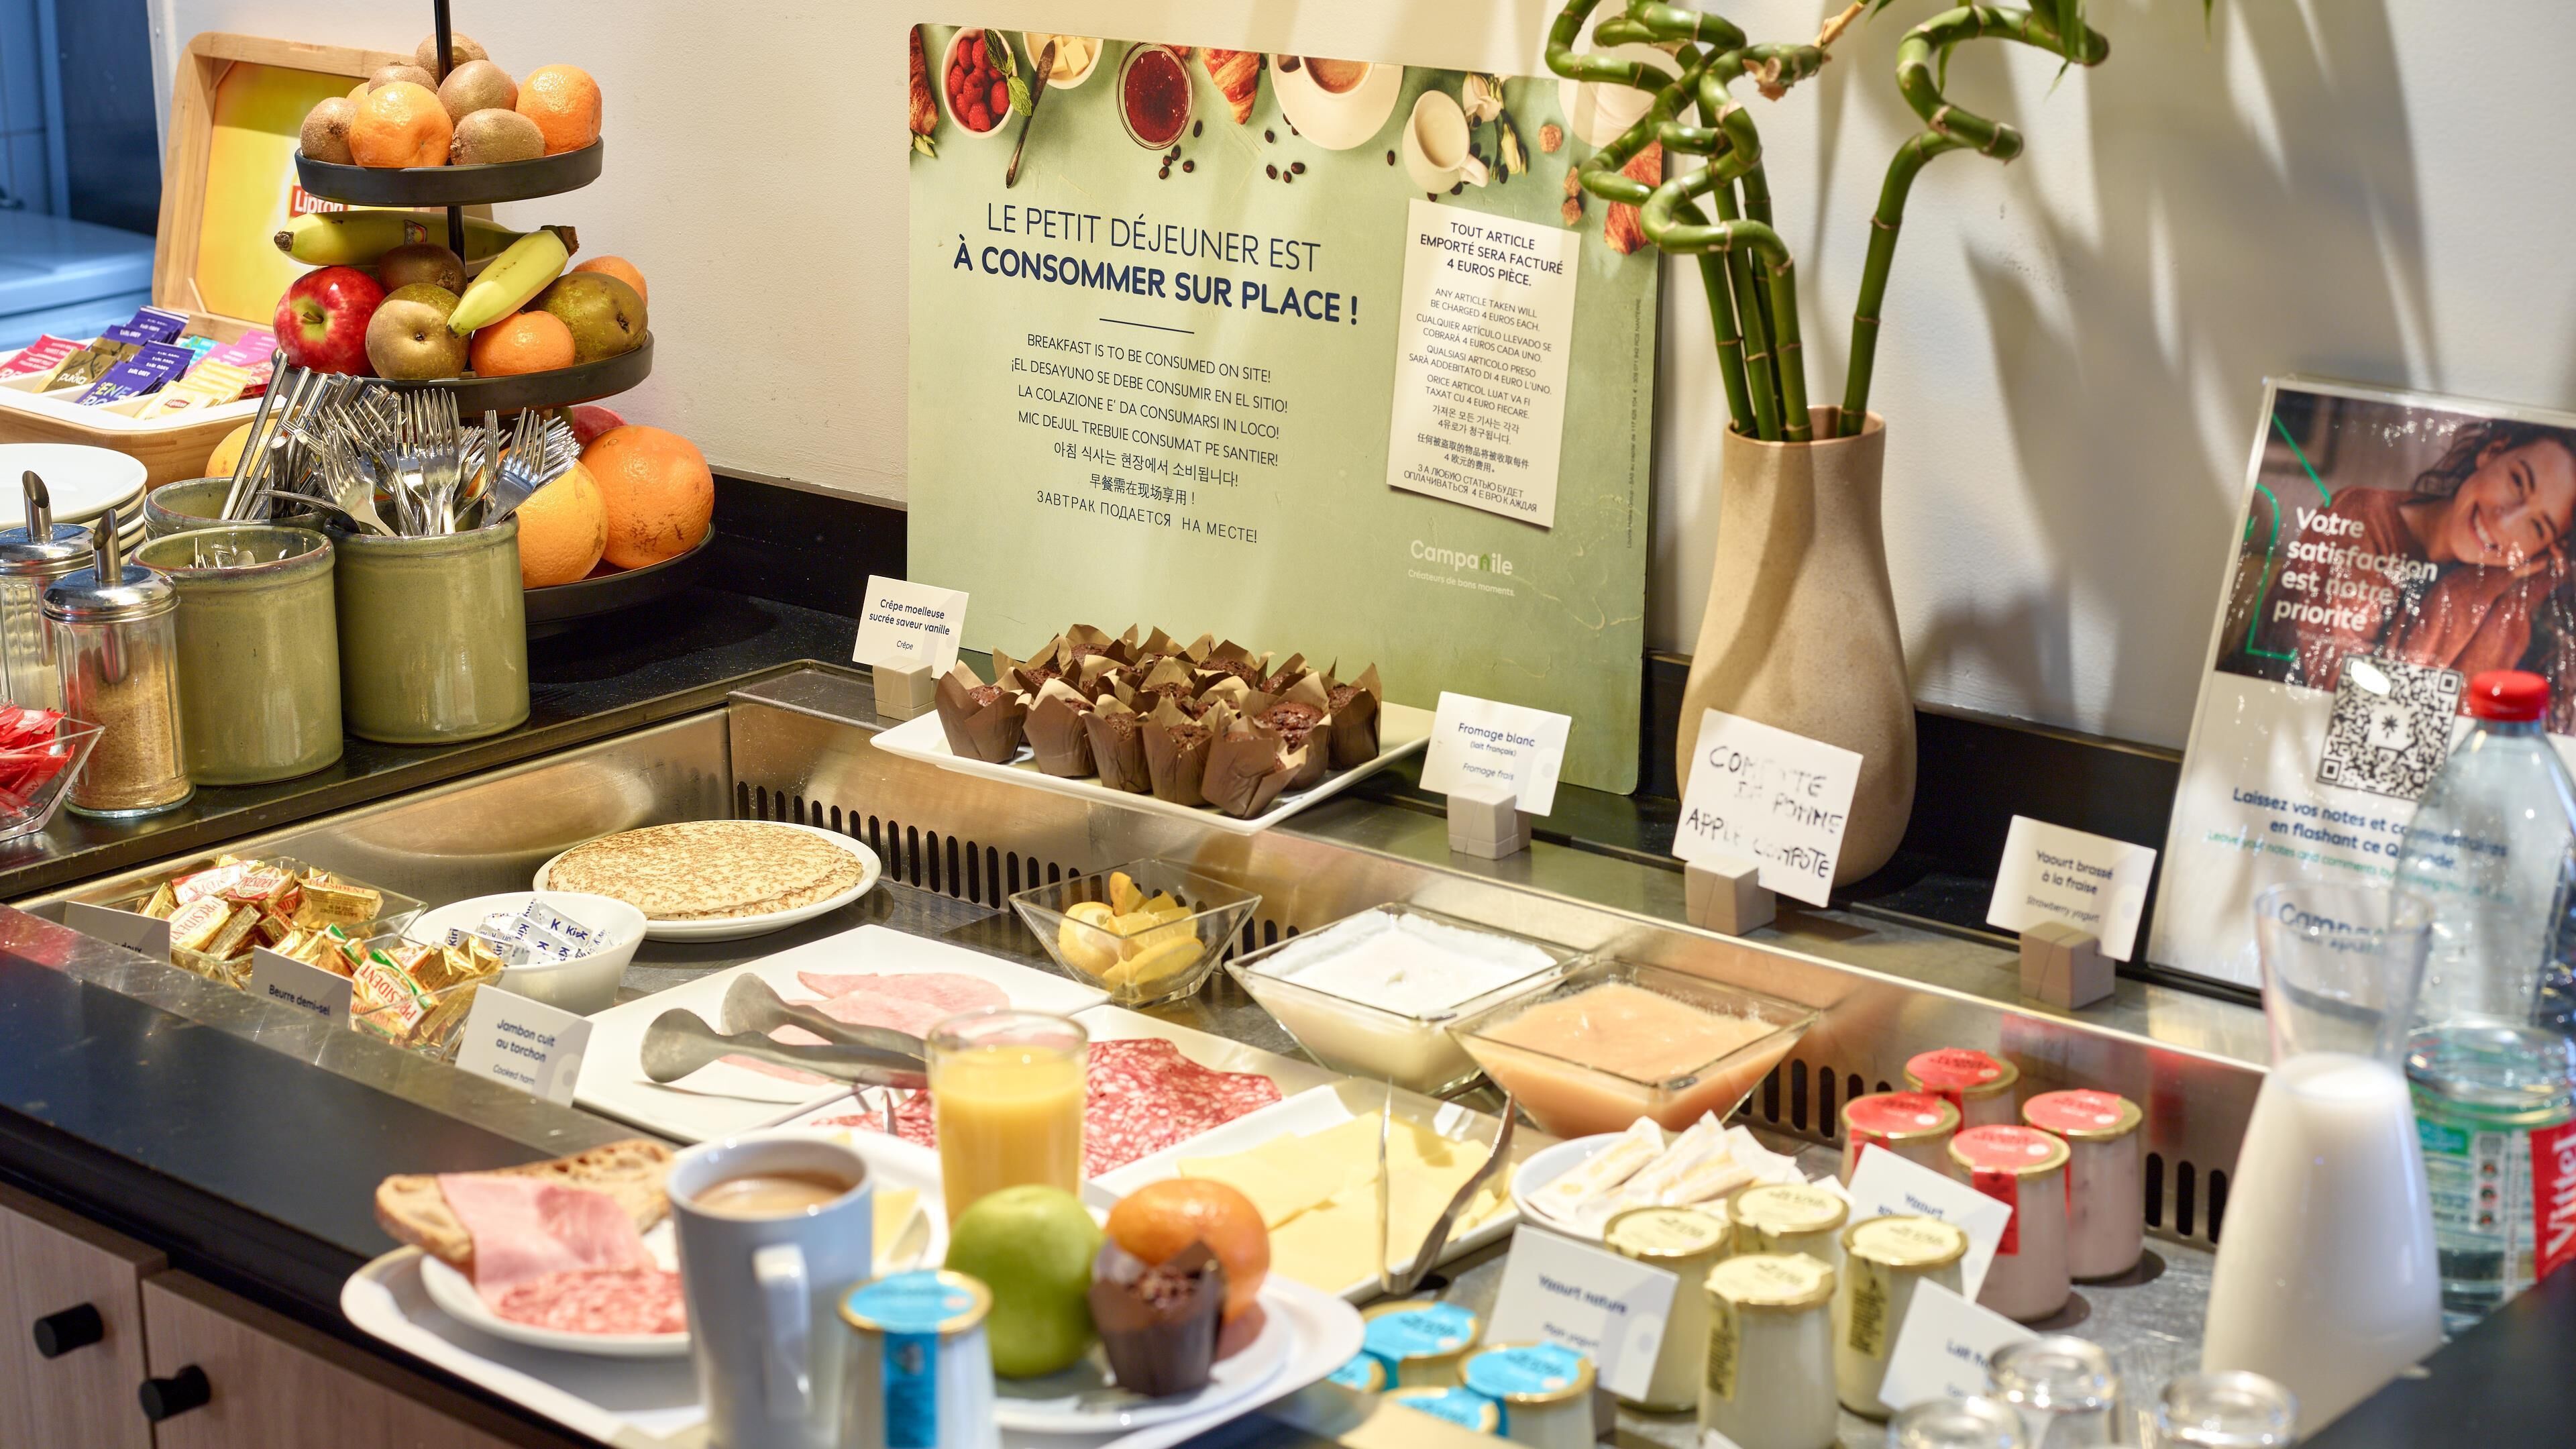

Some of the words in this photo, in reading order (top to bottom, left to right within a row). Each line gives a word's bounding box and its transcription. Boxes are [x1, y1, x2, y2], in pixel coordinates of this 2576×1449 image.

[988, 203, 1016, 233] LE
[1026, 209, 1101, 243] PETIT
[1112, 213, 1258, 265] DÉJEUNER
[1271, 238, 1321, 272] EST
[1451, 222, 1483, 238] TOUT
[1487, 231, 1535, 250] ARTICLE
[1421, 234, 1474, 255] EMPORTÉ
[1478, 246, 1506, 262] SERA
[1510, 254, 1563, 274] FACTURÉ
[954, 234, 973, 270] À
[981, 247, 1165, 298] CONSOMMER
[1175, 272, 1231, 307] SUR
[1242, 282, 1340, 322] PLACE
[1448, 258, 1454, 268] 4
[1458, 260, 1495, 277] EUROS
[1499, 268, 1532, 286] PIÈCE.
[1431, 300, 1440, 309] BE
[1442, 302, 1479, 317] CHARGED
[1489, 313, 1514, 325] EUROS
[1517, 319, 1540, 331] EACH.
[1436, 288, 1452, 298] ANY
[1454, 292, 1487, 307] ARTICLE
[1489, 300, 1515, 313] TAKEN
[1518, 306, 1537, 317] WILL
[1417, 313, 1460, 330] CUALQUIER
[1462, 324, 1501, 339] ARTÍCULO
[1503, 333, 1541, 349] LLEVADO
[1543, 343, 1552, 352] SE
[1424, 328, 1460, 343] COBRARÁ
[1470, 339, 1495, 352] EUROS
[1497, 345, 1519, 356] CADA
[1522, 350, 1542, 362] UNO.
[1028, 334, 1091, 354] BREAKFAST
[1095, 344, 1104, 357] IS
[1108, 346, 1124, 360] TO
[1128, 350, 1142, 362] BE
[1146, 352, 1215, 373] CONSUMED
[1220, 364, 1238, 378] ON
[1242, 367, 1271, 382] SITE!
[1409, 354, 1428, 364] SARÀ
[1431, 360, 1481, 377] ADDEBITATO
[1484, 371, 1491, 380] DI
[1501, 376, 1522, 387] EURO
[1427, 345, 1466, 360] QUALSIASI
[1468, 355, 1508, 370] ARTICOLO
[1511, 365, 1536, 378] PRESO
[1012, 358, 1027, 372] ¡EL
[1031, 361, 1093, 381] DESAYUNO
[1097, 372, 1109, 384] SE
[1114, 374, 1142, 389] DEBE
[1147, 380, 1211, 401] CONSUMIR
[1216, 390, 1231, 404] EN
[1236, 393, 1249, 407] EL
[1253, 396, 1287, 413] SITIO!
[1428, 374, 1449, 386] ORICE
[1452, 381, 1485, 395] ARTICOL
[1488, 389, 1508, 400] LUAT
[1019, 384, 1032, 398] LA
[1036, 388, 1103, 409] COLAZIONE
[1108, 399, 1115, 411] E'
[1120, 401, 1136, 415] DA
[1140, 405, 1219, 429] CONSUMARSI
[1224, 419, 1236, 431] IN
[1241, 421, 1279, 439] LOCO!
[1426, 386, 1452, 399] TAXAT
[1454, 394, 1464, 402] CU
[1474, 398, 1495, 410] EURO
[1497, 405, 1529, 419] FIECARE.
[1433, 405, 1456, 418] 가져온
[1459, 411, 1474, 423] 모든
[1477, 416, 1501, 429] 기사는
[1503, 422, 1519, 434] 각각
[1438, 419, 1466, 433] 4유로가
[1470, 426, 1511, 445] 청구됩니다.
[1019, 411, 1039, 425] MIC
[1043, 415, 1079, 432] DEJUL
[1082, 421, 1128, 440] TREBUIE
[1132, 431, 1201, 452] CONSUMAT
[1206, 442, 1220, 456] PE
[1224, 445, 1277, 466] SANTIER!
[1055, 442, 1077, 459] 아침
[1082, 445, 1116, 465] 식사는
[1121, 452, 1168, 475] 현장에서
[1173, 464, 1238, 486] 소비됩니다!
[1404, 470, 1468, 494] ОПЛАЧИВАТЬСЯ
[1432, 468, 1461, 482] ЛЮБУЮ
[1463, 476, 1496, 490] СТАТЬЮ
[1497, 484, 1523, 498] БУДЕТ
[1037, 490, 1095, 513] ЗАВТРАК
[1101, 502, 1171, 527] ПОДАЕТСЯ
[1183, 517, 1200, 532] НА
[1207, 522, 1256, 543] МЕСТЕ!
[2296, 506, 2365, 538] Votre
[1411, 540, 1513, 576] Campanile
[2288, 540, 2438, 582] satisfaction
[1409, 570, 1444, 583] Créateurs
[1446, 577, 1456, 585] de
[1458, 579, 1476, 589] bons
[1478, 584, 1515, 596] moments.
[2282, 571, 2320, 592] est
[2325, 578, 2394, 604] notre
[869, 612, 894, 624] sucrée
[896, 619, 922, 630] saveur
[924, 624, 950, 635] vanille
[880, 599, 903, 612] Crêpe
[905, 605, 945, 619] moelleuse
[2273, 599, 2367, 631] priorité
[896, 640, 913, 650] Crêpe
[1458, 722, 1503, 742] Fromage
[1507, 732, 1535, 747] blanc
[1470, 741, 1484, 750] (lait
[1487, 744, 1517, 757] français)
[1462, 763, 1495, 777] Fromage
[1497, 770, 1513, 780] frais
[2233, 788, 2288, 812] Laissez
[2294, 802, 2318, 819] vos
[2322, 808, 2365, 827] notes
[2370, 818, 2387, 831] et
[2270, 820, 2288, 835] en
[2294, 823, 2357, 849] flashant
[2363, 841, 2381, 854] ce
[2053, 874, 2063, 886] la
[2065, 877, 2098, 895] fraise
[448, 928, 458, 947] Kiri
[269, 985, 294, 1002] Beurre
[297, 995, 330, 1016] demi-sel
[497, 1020, 535, 1040] Jambon
[537, 1034, 555, 1046] cuit
[496, 1038, 508, 1049] au
[510, 1042, 546, 1063] torchon
[493, 1064, 518, 1080] Cooked
[520, 1074, 535, 1085] ham
